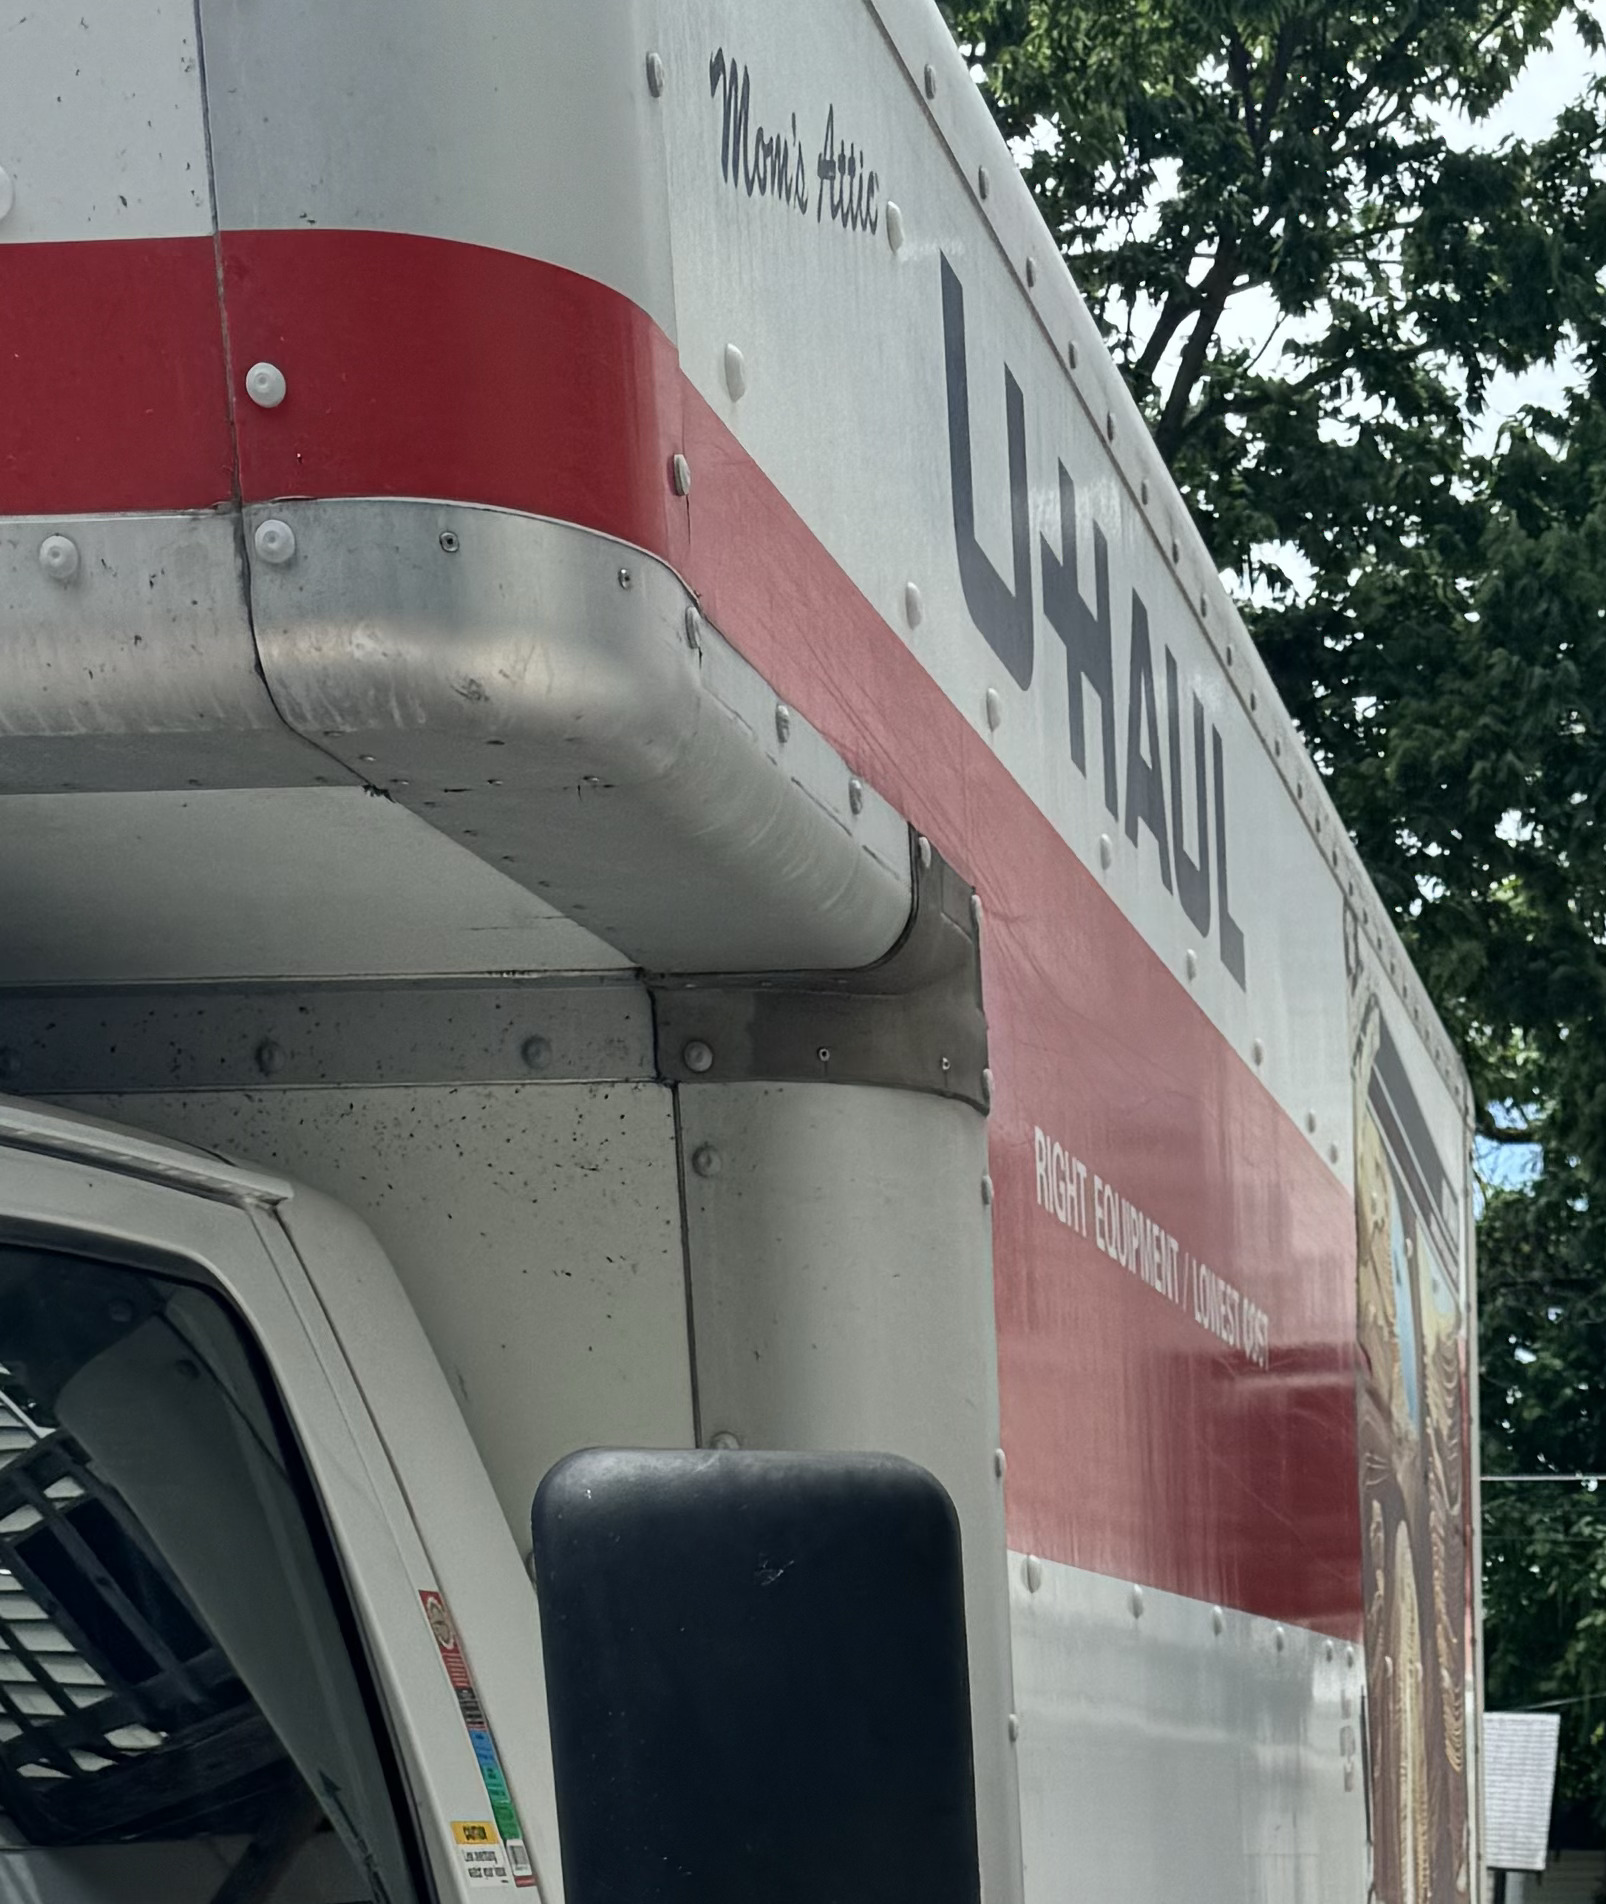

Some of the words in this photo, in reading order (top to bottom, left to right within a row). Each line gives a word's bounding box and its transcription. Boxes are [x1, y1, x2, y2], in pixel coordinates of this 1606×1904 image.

[709, 46, 808, 216] Mom's
[816, 103, 879, 235] Attic
[1034, 1125, 1088, 1239] RIGHT
[1094, 1174, 1180, 1303] EQUIPMENT
[1191, 1257, 1242, 1351] LOWEST
